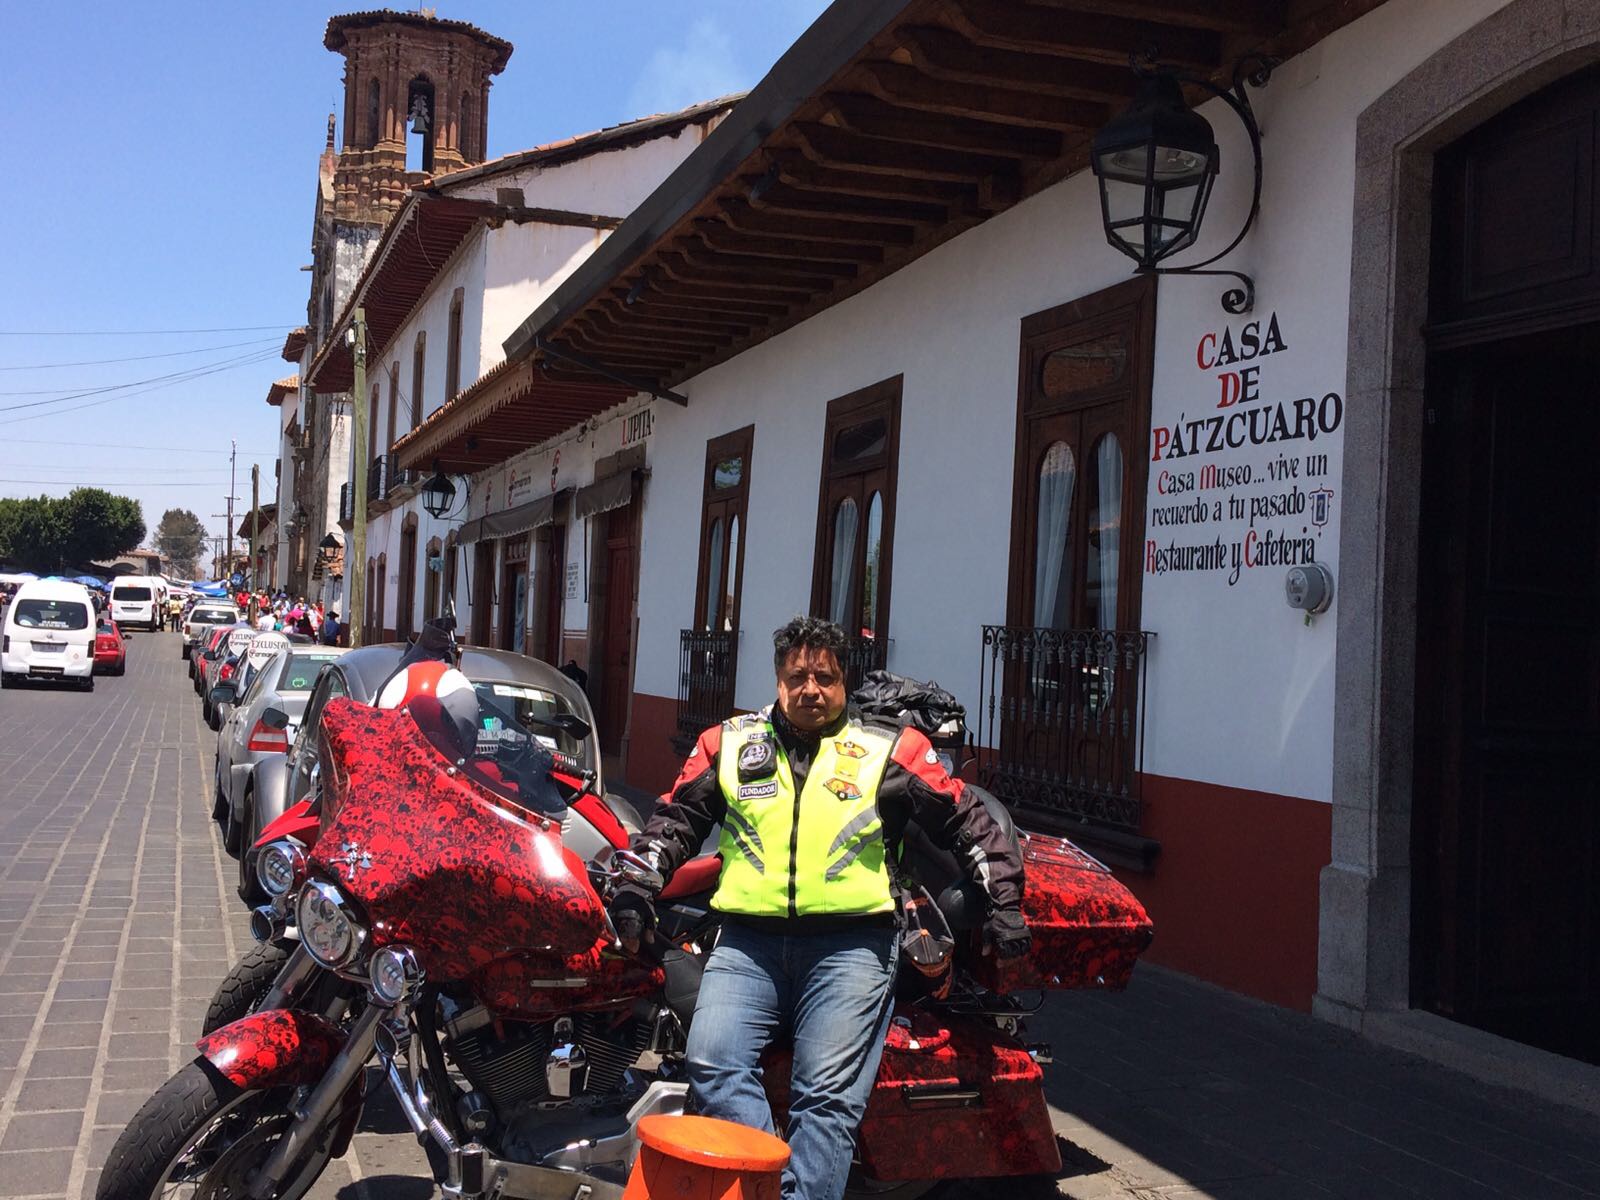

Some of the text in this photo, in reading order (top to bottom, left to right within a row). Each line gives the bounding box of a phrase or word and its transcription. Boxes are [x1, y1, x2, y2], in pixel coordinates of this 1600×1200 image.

[1196, 311, 1288, 370] CASA
[1216, 365, 1261, 409] DE
[621, 408, 652, 446] LUPITA
[1151, 392, 1343, 462] PÁTZCUARO
[1158, 470, 1195, 497] Casa
[1306, 454, 1328, 477] un
[1152, 485, 1306, 527] recuerdo a tu pasado
[1145, 533, 1227, 576] Restaurante
[1228, 541, 1243, 586] y
[740, 784, 776, 797] FUNDADOR
